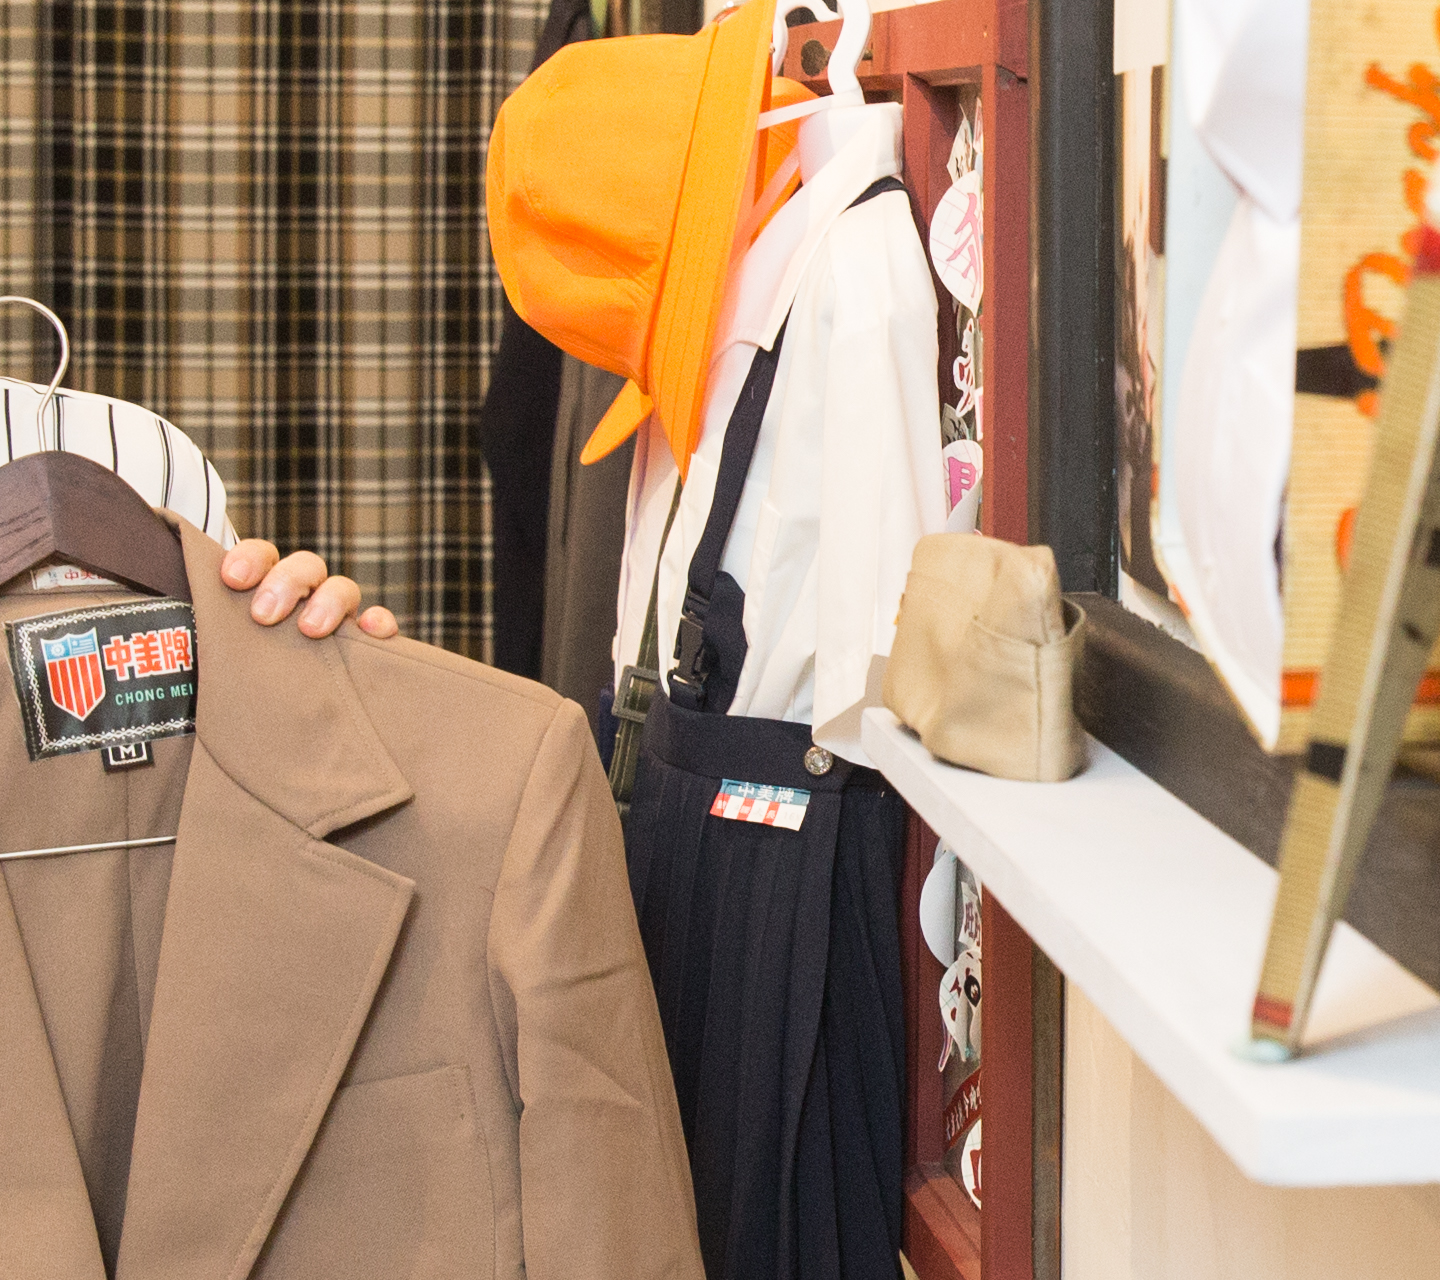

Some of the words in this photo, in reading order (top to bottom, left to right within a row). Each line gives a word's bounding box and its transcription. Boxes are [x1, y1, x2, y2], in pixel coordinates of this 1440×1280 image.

[102, 626, 193, 681] 中美牌
[115, 688, 165, 705] CHONG
[170, 683, 193, 697] MEI
[120, 745, 137, 759] M
[738, 782, 795, 803] 中美牌
